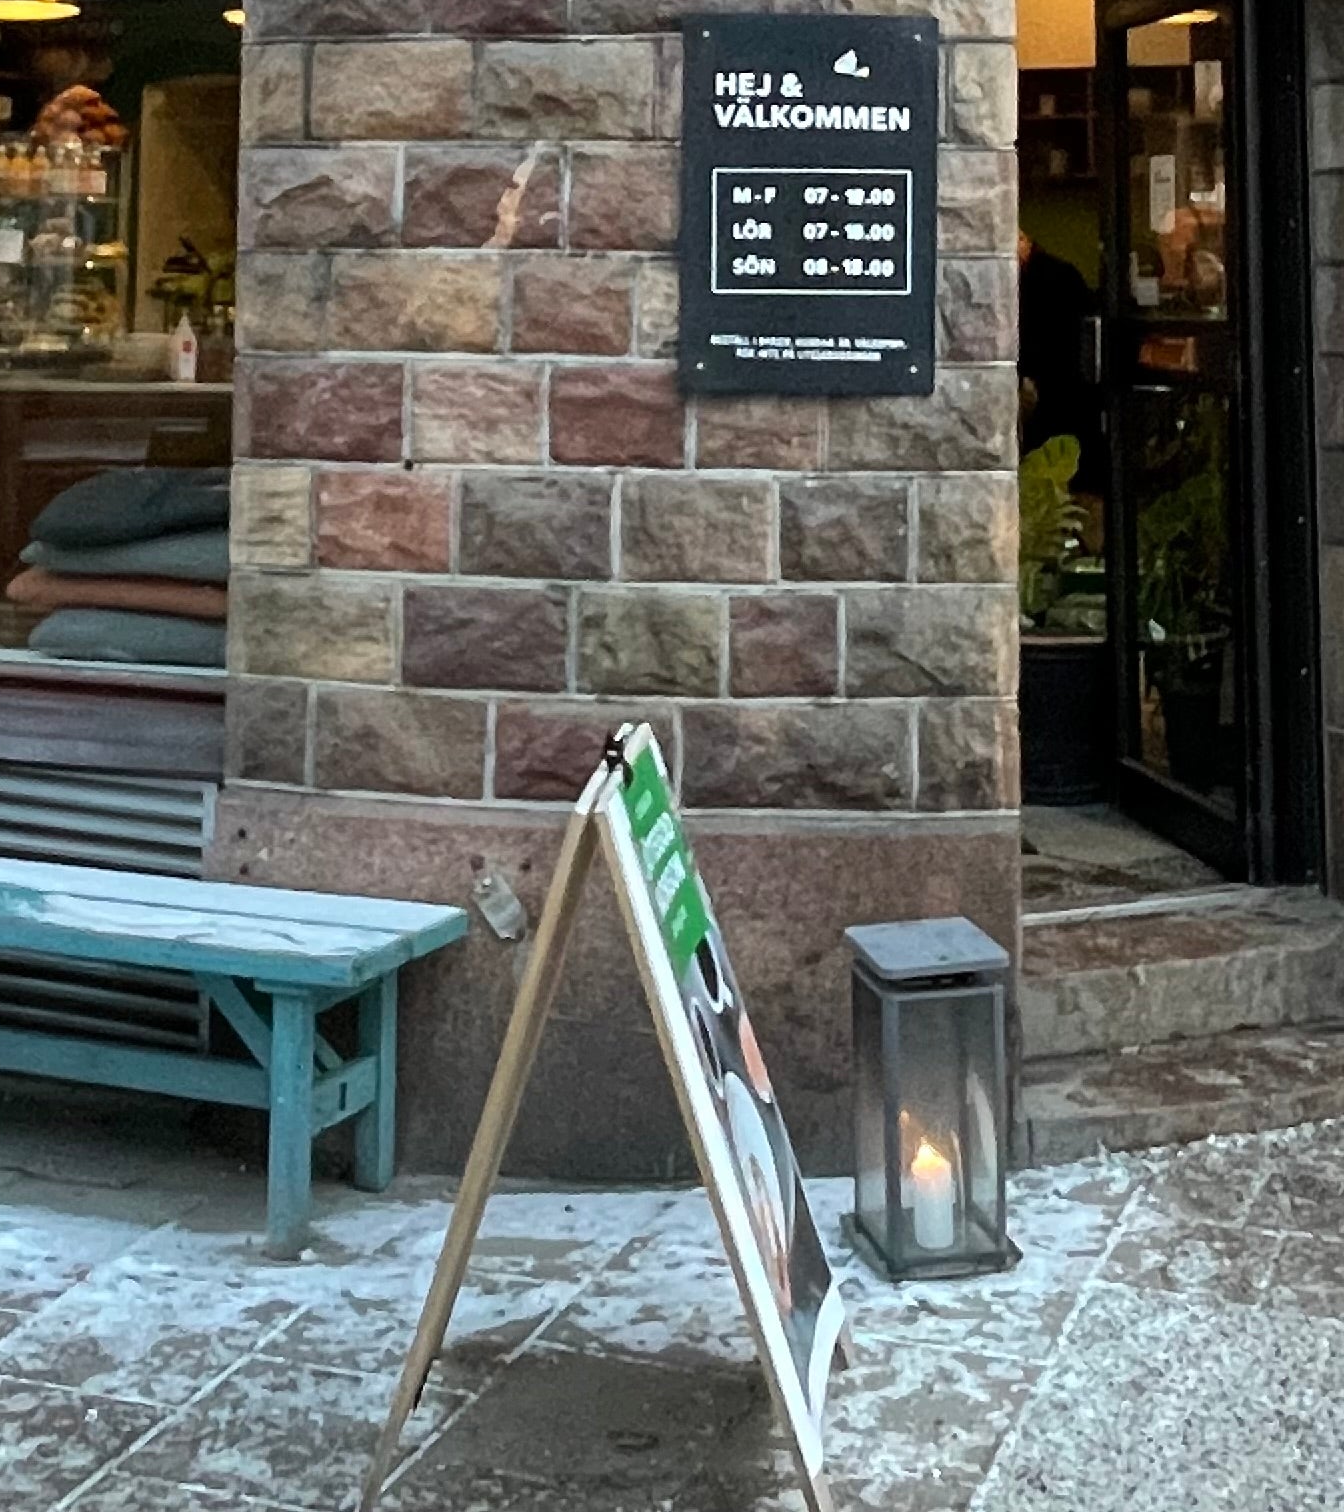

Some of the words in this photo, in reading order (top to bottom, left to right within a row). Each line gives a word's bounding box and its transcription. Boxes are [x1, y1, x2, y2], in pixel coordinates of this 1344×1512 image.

[714, 72, 772, 98] HEJ
[780, 73, 804, 98] &
[713, 95, 912, 132] VÄLKOMMEN
[732, 218, 772, 240] LÖR
[732, 254, 776, 276] SÖN
